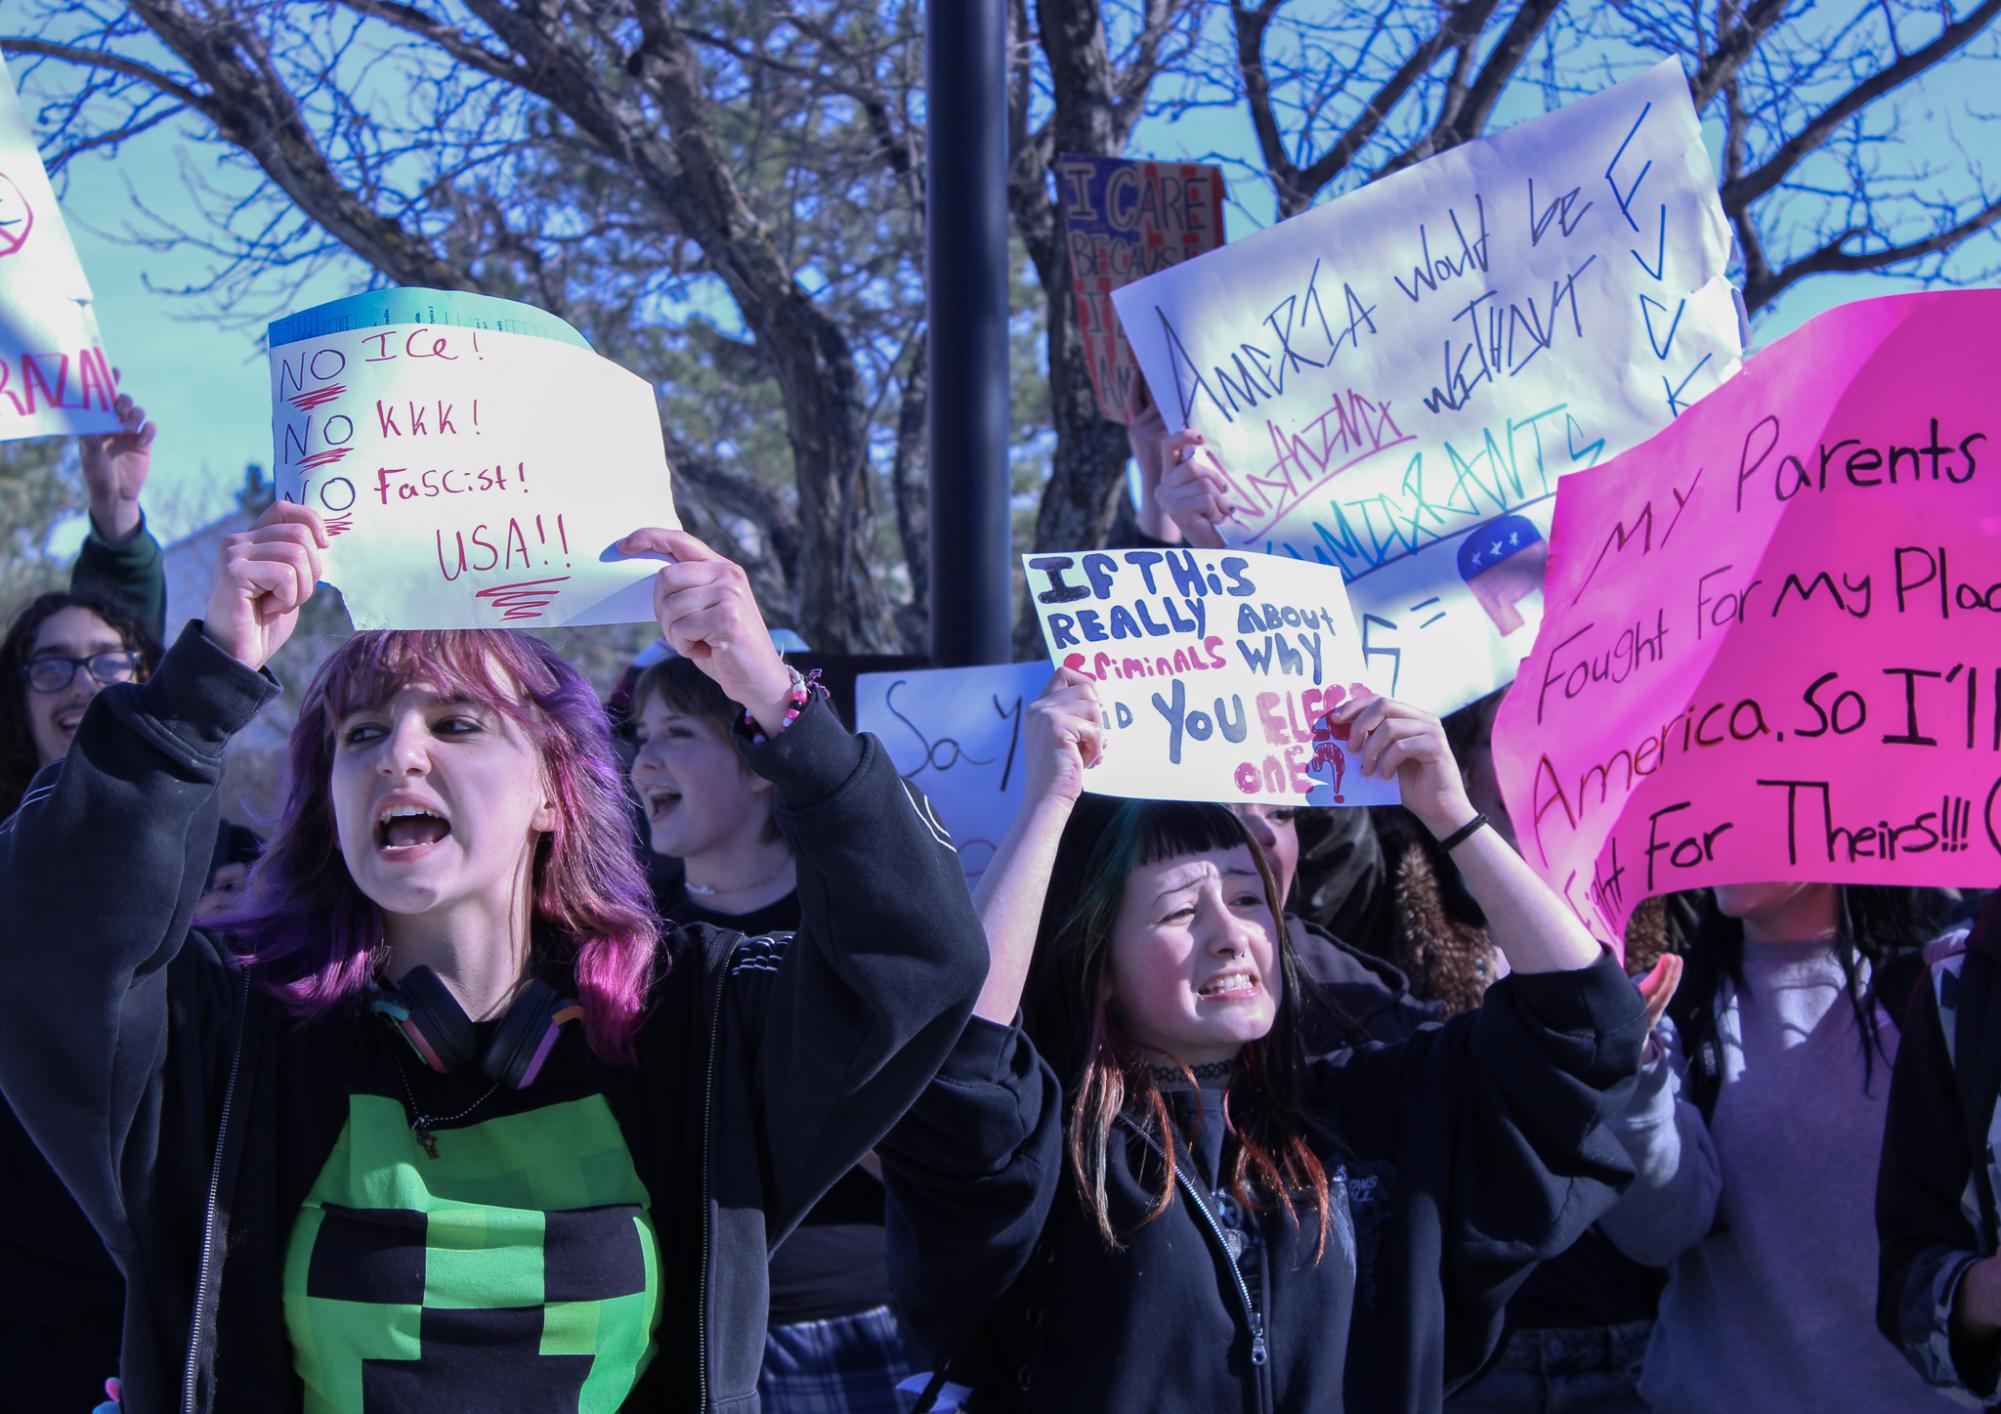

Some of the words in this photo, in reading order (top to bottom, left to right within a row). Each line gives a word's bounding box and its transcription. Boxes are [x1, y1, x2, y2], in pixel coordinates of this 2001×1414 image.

[1067, 168, 1092, 217] I
[1109, 169, 1208, 231] CARE
[280, 348, 346, 402] NO
[284, 414, 354, 465] NO
[1736, 414, 1988, 513] Parents
[436, 513, 572, 582] USA!!
[1028, 552, 1119, 604] IF
[1047, 596, 1206, 650] REALLY
[1537, 608, 1669, 726] Fought
[1697, 564, 1763, 641] For
[1645, 801, 1734, 892] For
[1757, 780, 1971, 866] Theirs!!!
